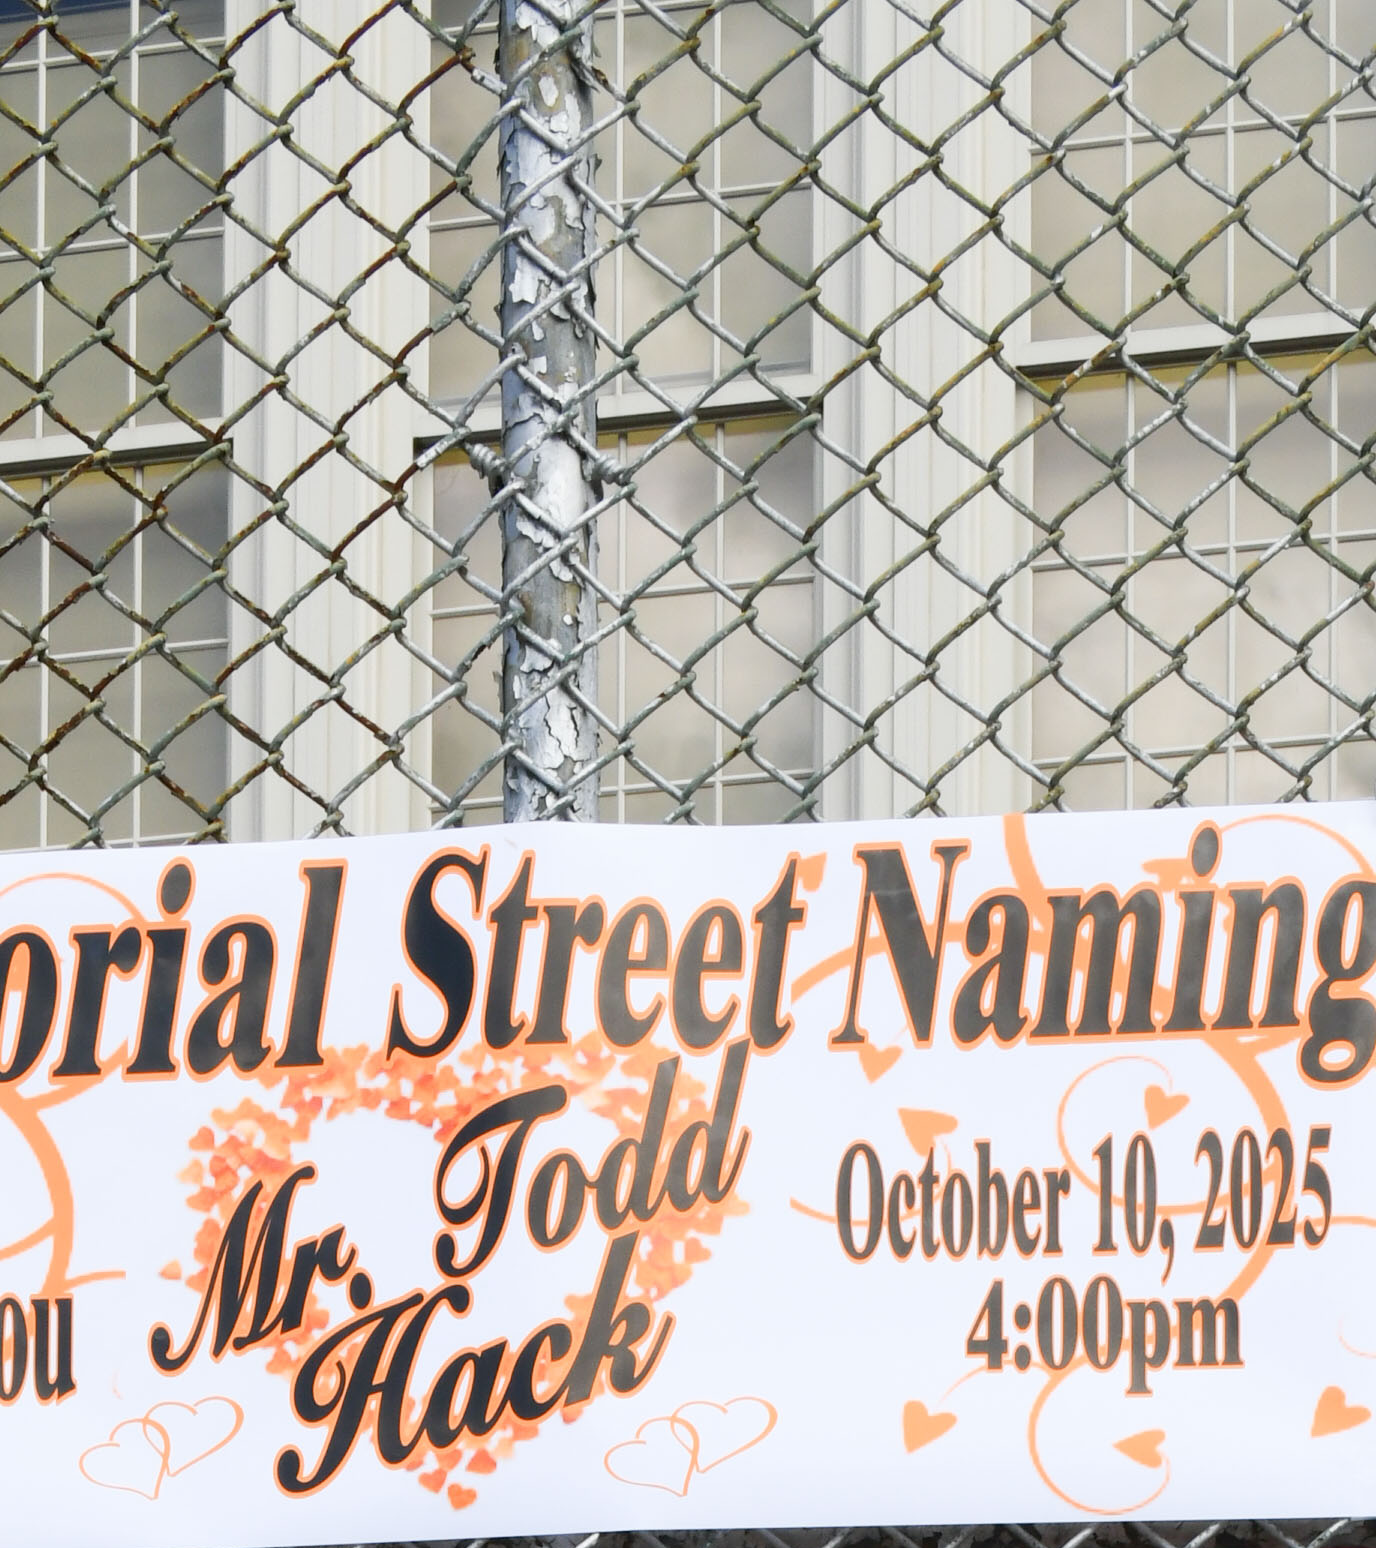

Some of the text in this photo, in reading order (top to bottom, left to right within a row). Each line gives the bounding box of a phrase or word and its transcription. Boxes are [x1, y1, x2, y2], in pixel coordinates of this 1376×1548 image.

[384, 843, 806, 1064] Street
[149, 1036, 752, 1374] Mr. Todd
[835, 1123, 1334, 1286] October 10, 2025
[274, 1228, 677, 1496] Hack
[965, 1274, 1246, 1397] 4:00pm
